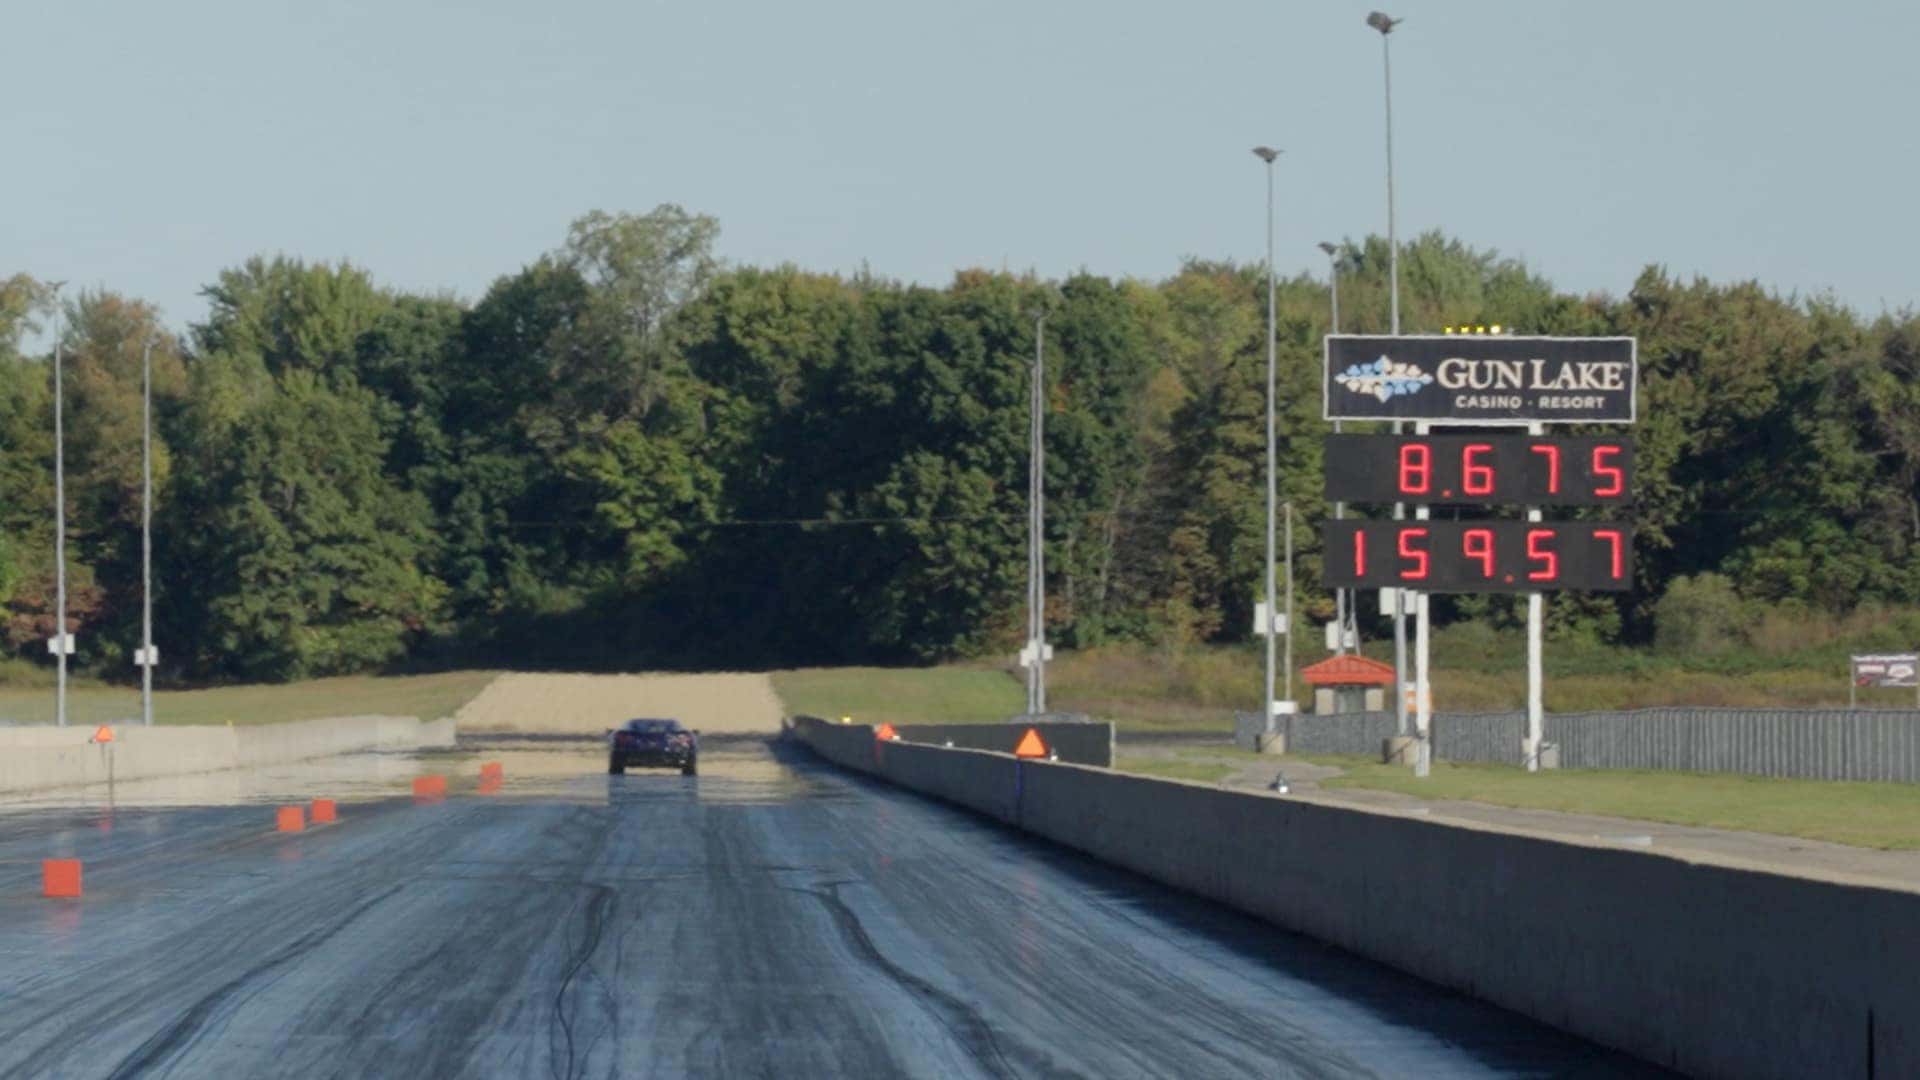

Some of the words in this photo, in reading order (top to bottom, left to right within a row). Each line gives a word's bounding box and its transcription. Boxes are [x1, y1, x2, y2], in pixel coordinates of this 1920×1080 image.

[1437, 358, 1525, 390] GUN
[1530, 359, 1625, 391] LAKE
[1455, 395, 1522, 409] CASINO
[1538, 396, 1606, 409] RESORT
[1399, 443, 1624, 497] 8.675
[1353, 528, 1623, 582] 159.57
